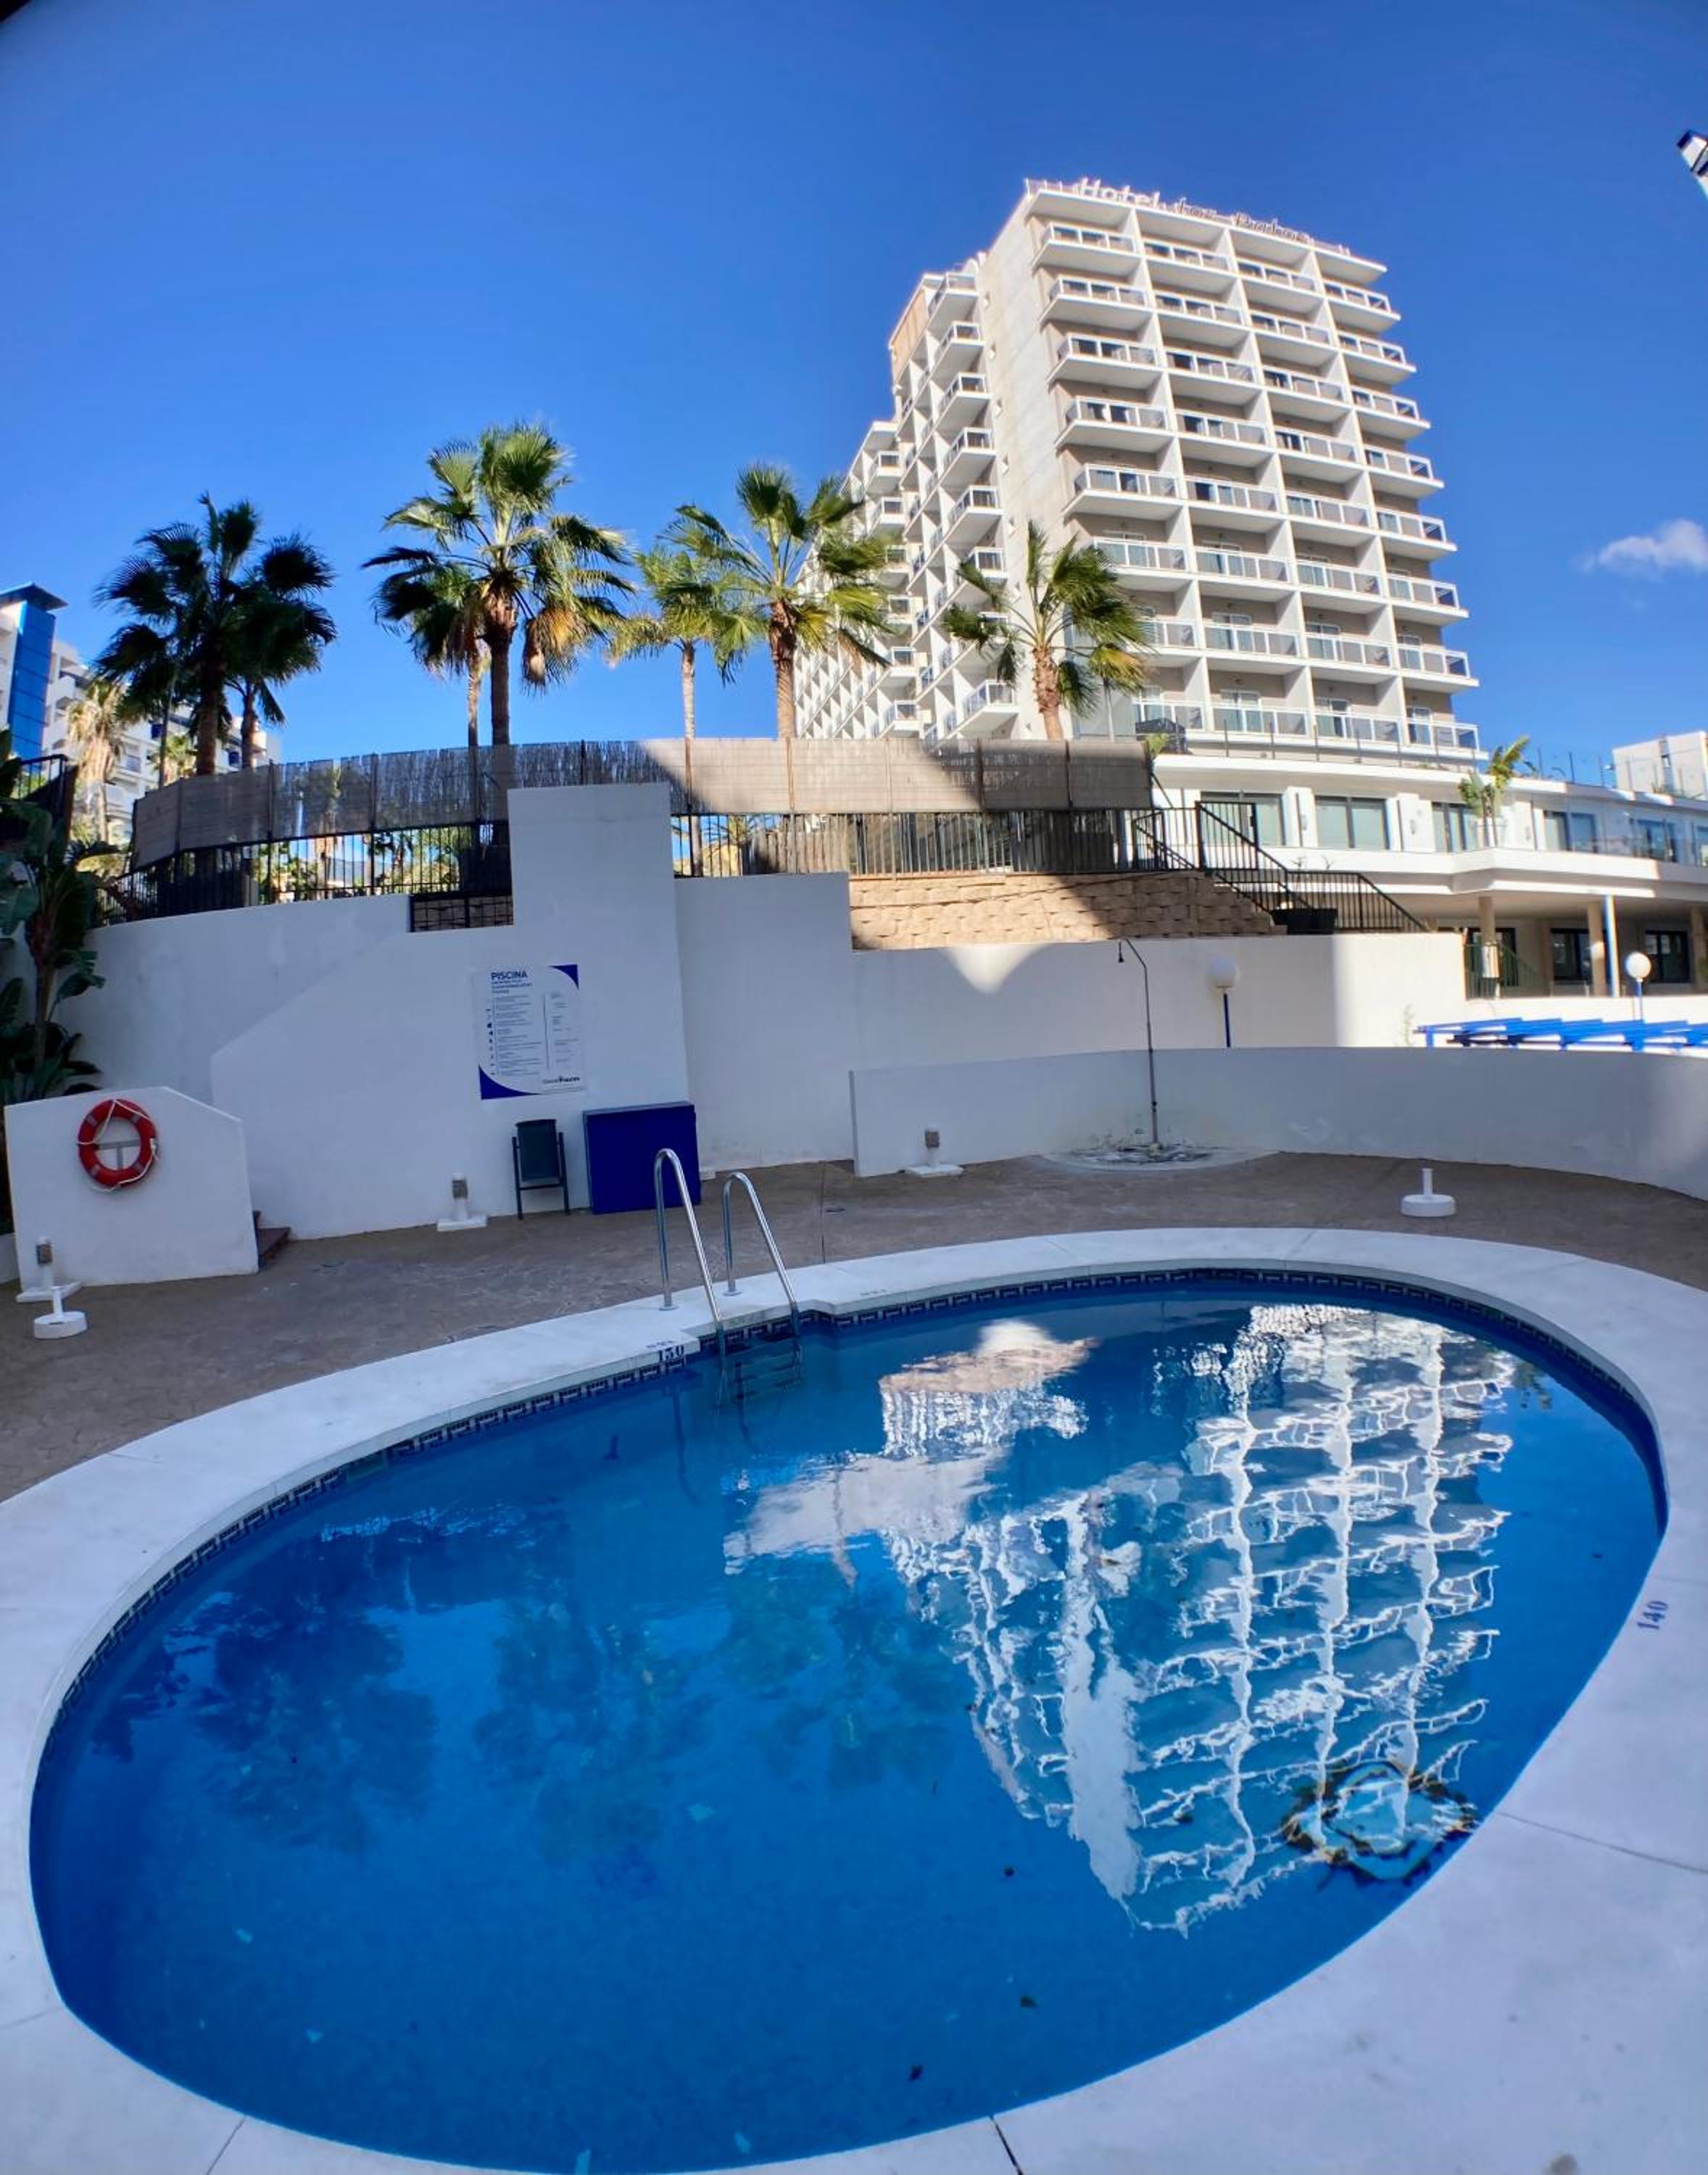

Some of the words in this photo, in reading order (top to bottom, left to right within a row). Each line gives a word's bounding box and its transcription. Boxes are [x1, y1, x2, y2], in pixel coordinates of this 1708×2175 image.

[1079, 177, 1161, 208] Hotel
[491, 970, 528, 980] PISCINA
[1636, 1600, 1668, 1629] 140
